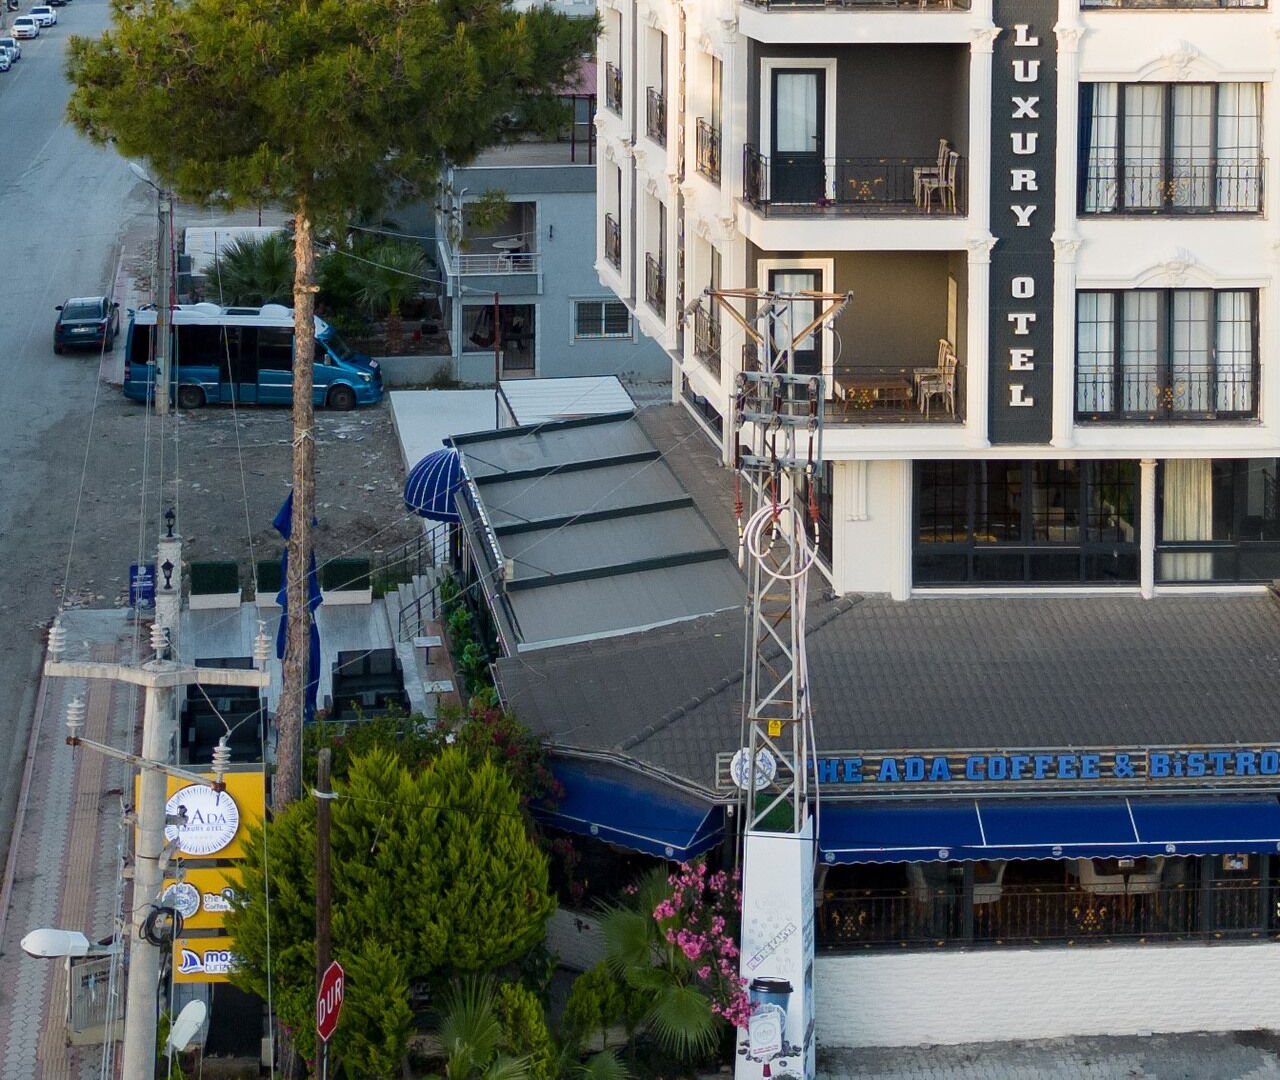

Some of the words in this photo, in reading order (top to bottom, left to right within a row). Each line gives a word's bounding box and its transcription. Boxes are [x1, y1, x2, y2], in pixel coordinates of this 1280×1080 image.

[1010, 24, 1040, 227] LUXURY
[1008, 276, 1037, 407] OTEL
[803, 758, 863, 783] HE
[878, 756, 952, 782] ADA
[966, 753, 1100, 781] COFFEE
[1113, 753, 1135, 778] &
[320, 974, 341, 1026] DUR
